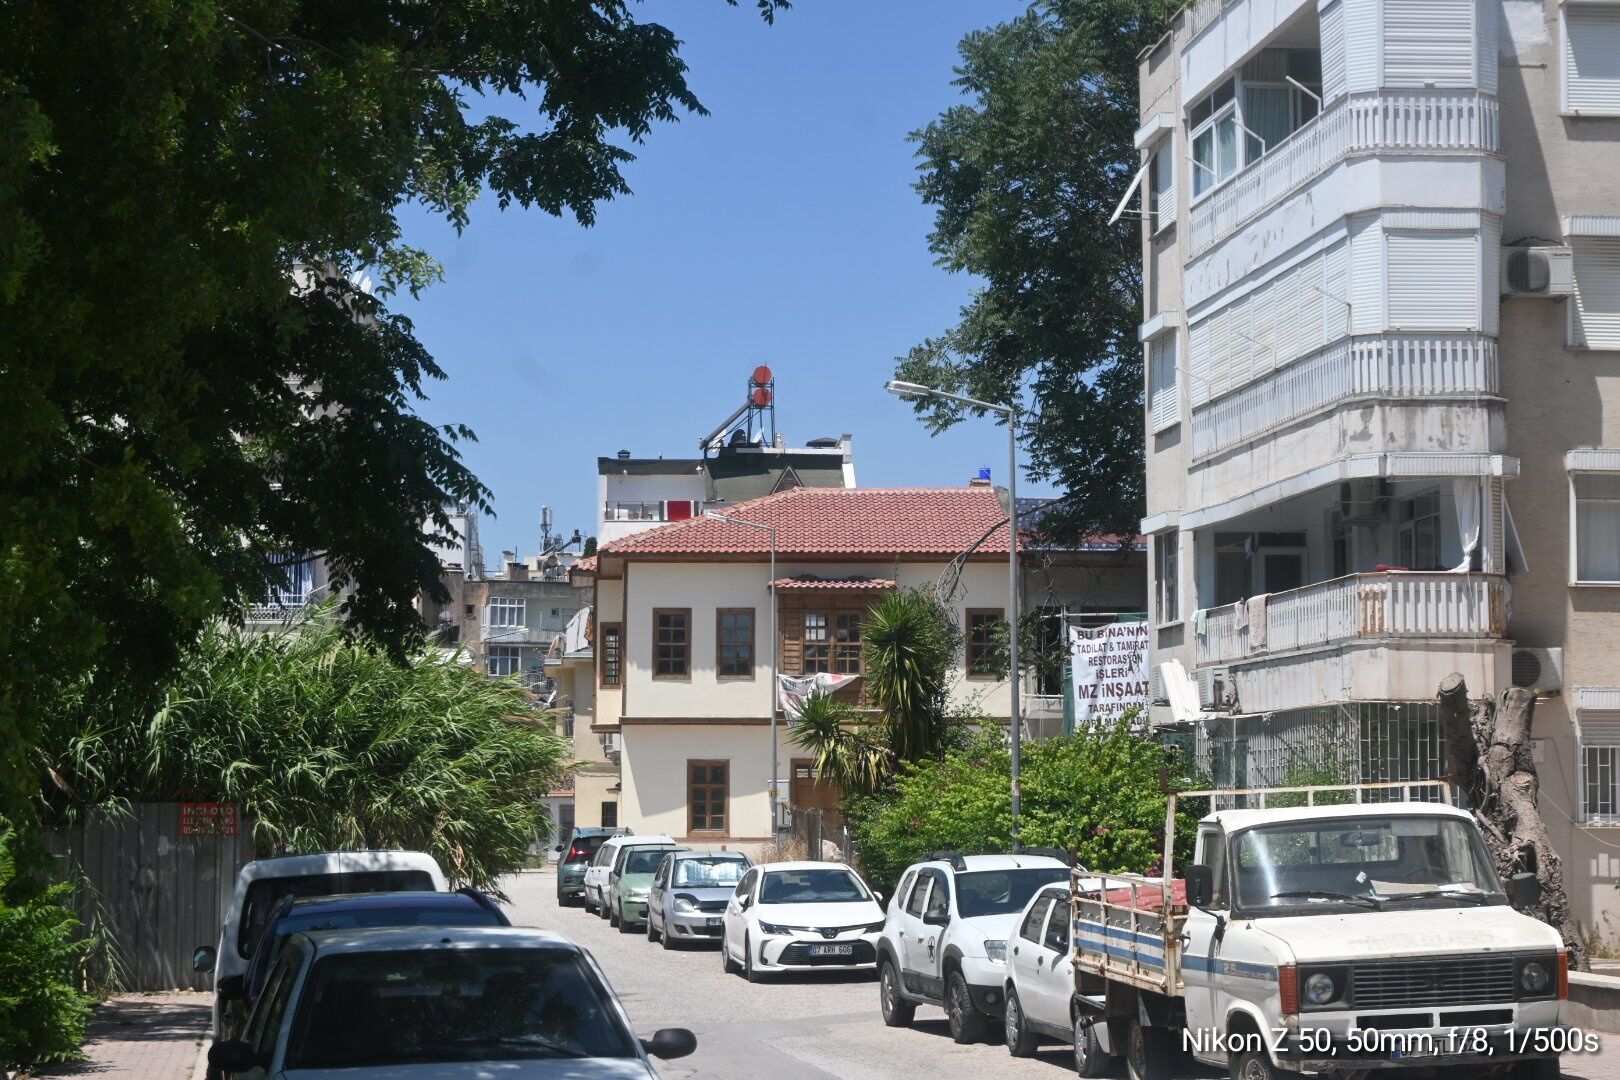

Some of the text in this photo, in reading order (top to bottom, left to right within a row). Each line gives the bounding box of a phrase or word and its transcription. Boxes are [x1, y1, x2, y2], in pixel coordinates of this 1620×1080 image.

[1077, 630, 1093, 640] BU
[1109, 641, 1115, 652] &
[1088, 654, 1143, 666] RESTORASYON
[1078, 683, 1098, 700] MZ
